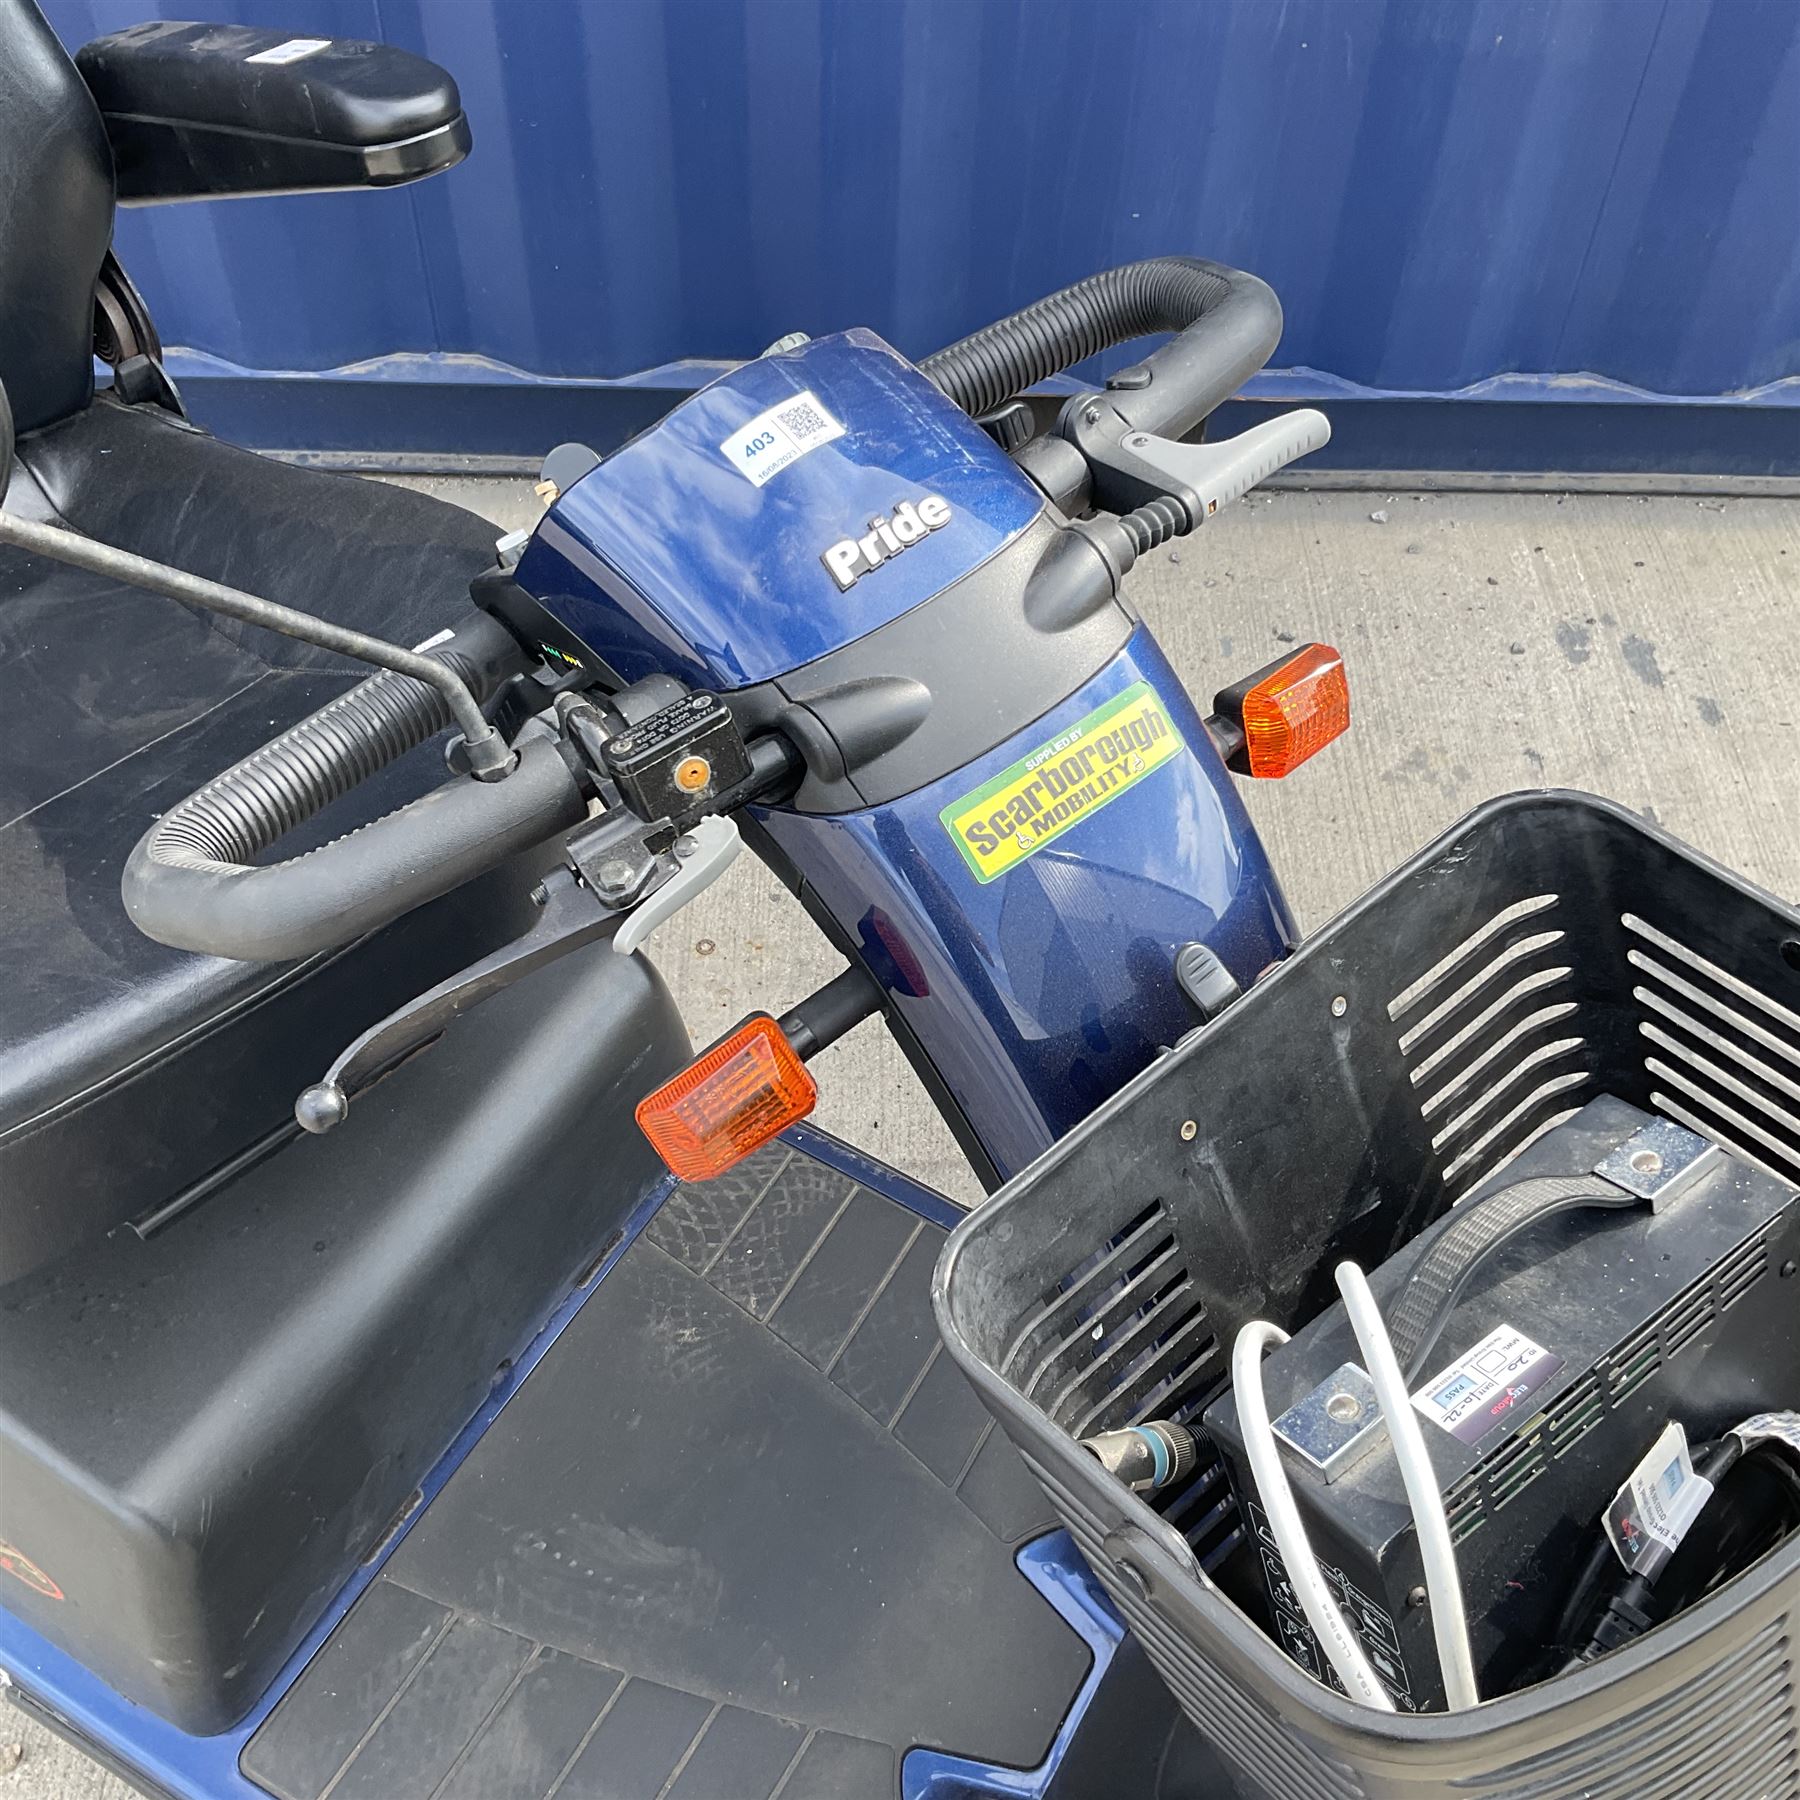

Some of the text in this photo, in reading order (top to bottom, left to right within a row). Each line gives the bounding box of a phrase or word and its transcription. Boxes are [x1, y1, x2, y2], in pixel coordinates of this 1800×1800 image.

[744, 431, 775, 460] 403
[757, 449, 798, 481] 16/08/2023
[820, 495, 952, 593] Pride
[1025, 728, 1084, 771] SUPPLIED BY
[966, 708, 1168, 856] Scarborough
[1030, 757, 1131, 836] MOBILITY
[1444, 1384, 1465, 1401] PASS
